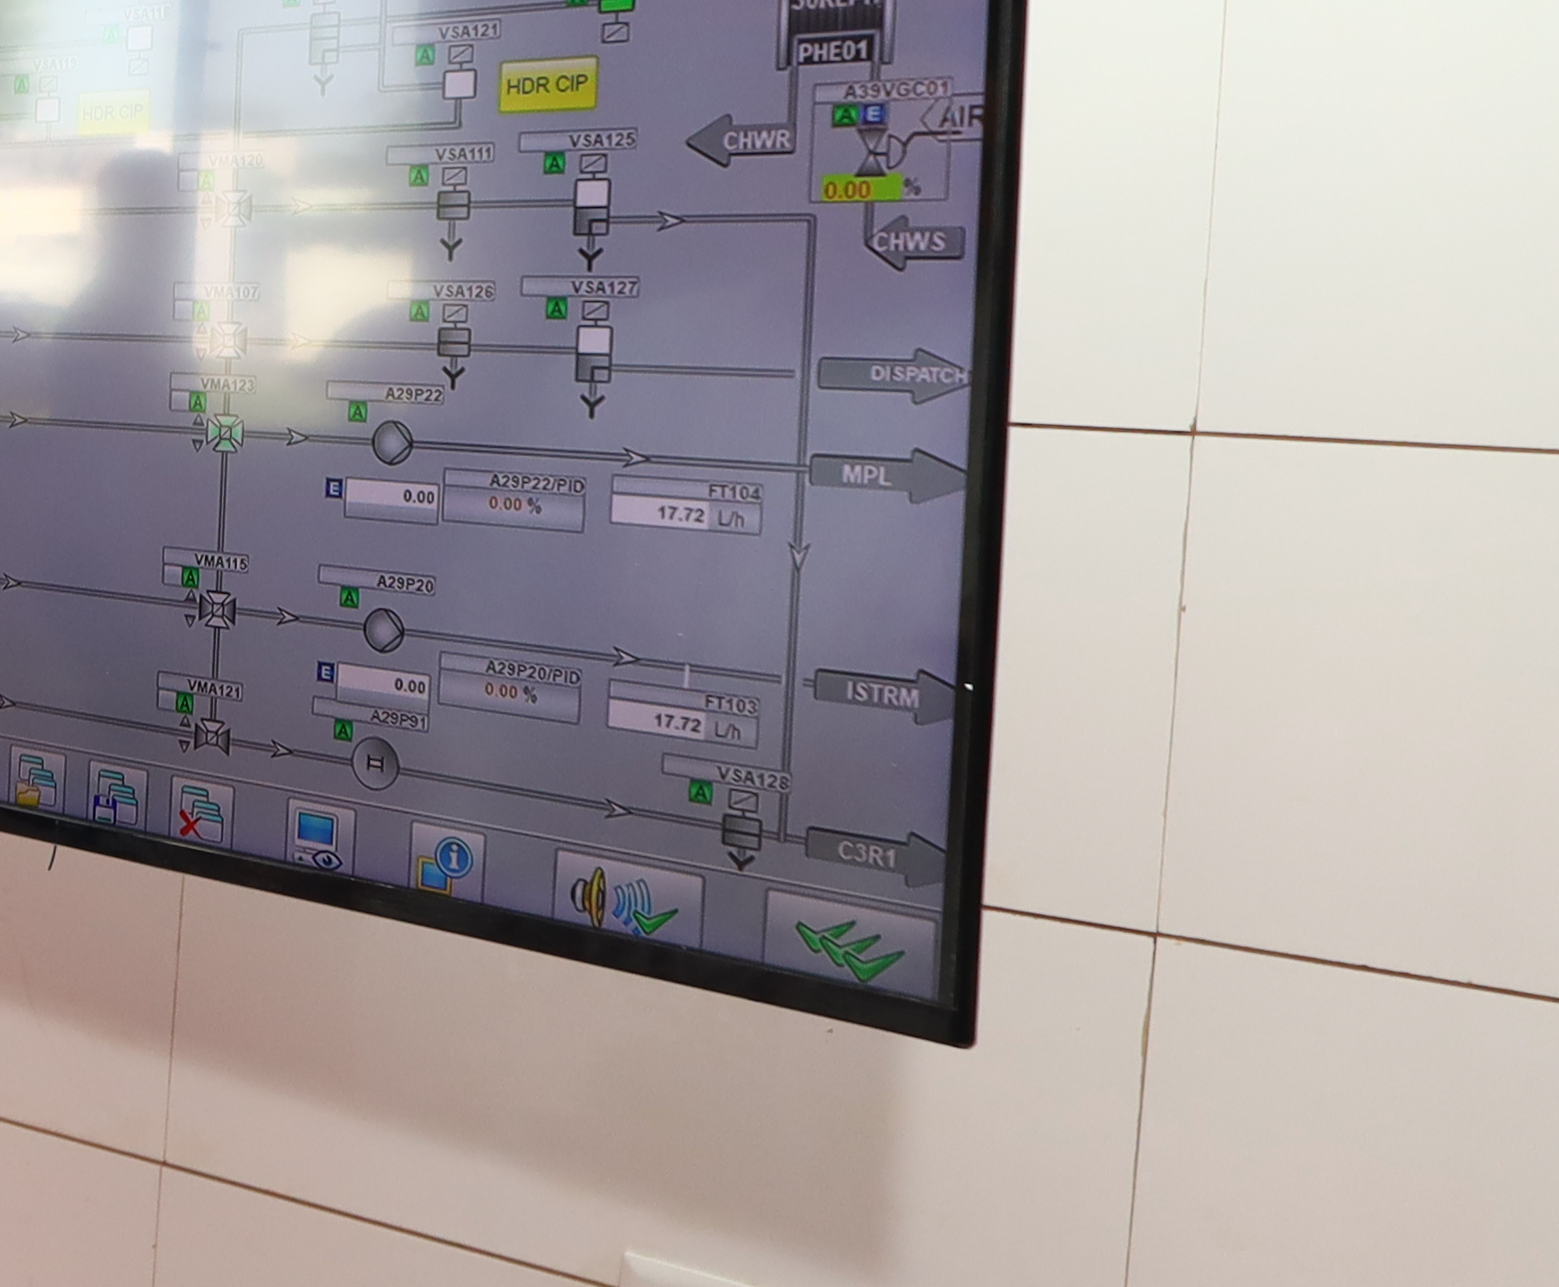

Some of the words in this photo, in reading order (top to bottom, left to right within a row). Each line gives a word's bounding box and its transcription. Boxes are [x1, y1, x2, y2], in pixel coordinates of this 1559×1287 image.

[438, 23, 500, 40] VSA121
[797, 38, 870, 63] PHE01
[506, 76, 549, 96] HDR
[556, 73, 589, 93] CIP
[843, 80, 949, 100] A39VGC01
[938, 104, 984, 128] AIR
[569, 132, 636, 148] VSA125
[723, 128, 791, 150] CHWR
[435, 146, 492, 162] VSA111
[872, 231, 947, 252] CHWS
[432, 284, 494, 299] VSA126
[571, 279, 638, 295] VSA127
[871, 364, 968, 384] DISPATCH
[200, 377, 255, 392] VMA123
[385, 386, 443, 403] A29P22
[489, 473, 585, 493] A29P22/PID
[842, 464, 892, 486] MPL
[403, 489, 435, 503] 0.00
[708, 484, 762, 502] FT104
[657, 505, 705, 523] 17.72
[718, 509, 745, 528] L/h
[485, 659, 581, 684] A29P20/PID
[187, 679, 241, 698] VMA121
[394, 677, 426, 694] 0.00
[847, 680, 920, 709] ISTRM
[704, 694, 758, 714] FT103
[654, 713, 702, 734] 17.72
[714, 720, 741, 740] L/h
[717, 765, 790, 790] VSA128
[838, 839, 897, 868] C3R1
